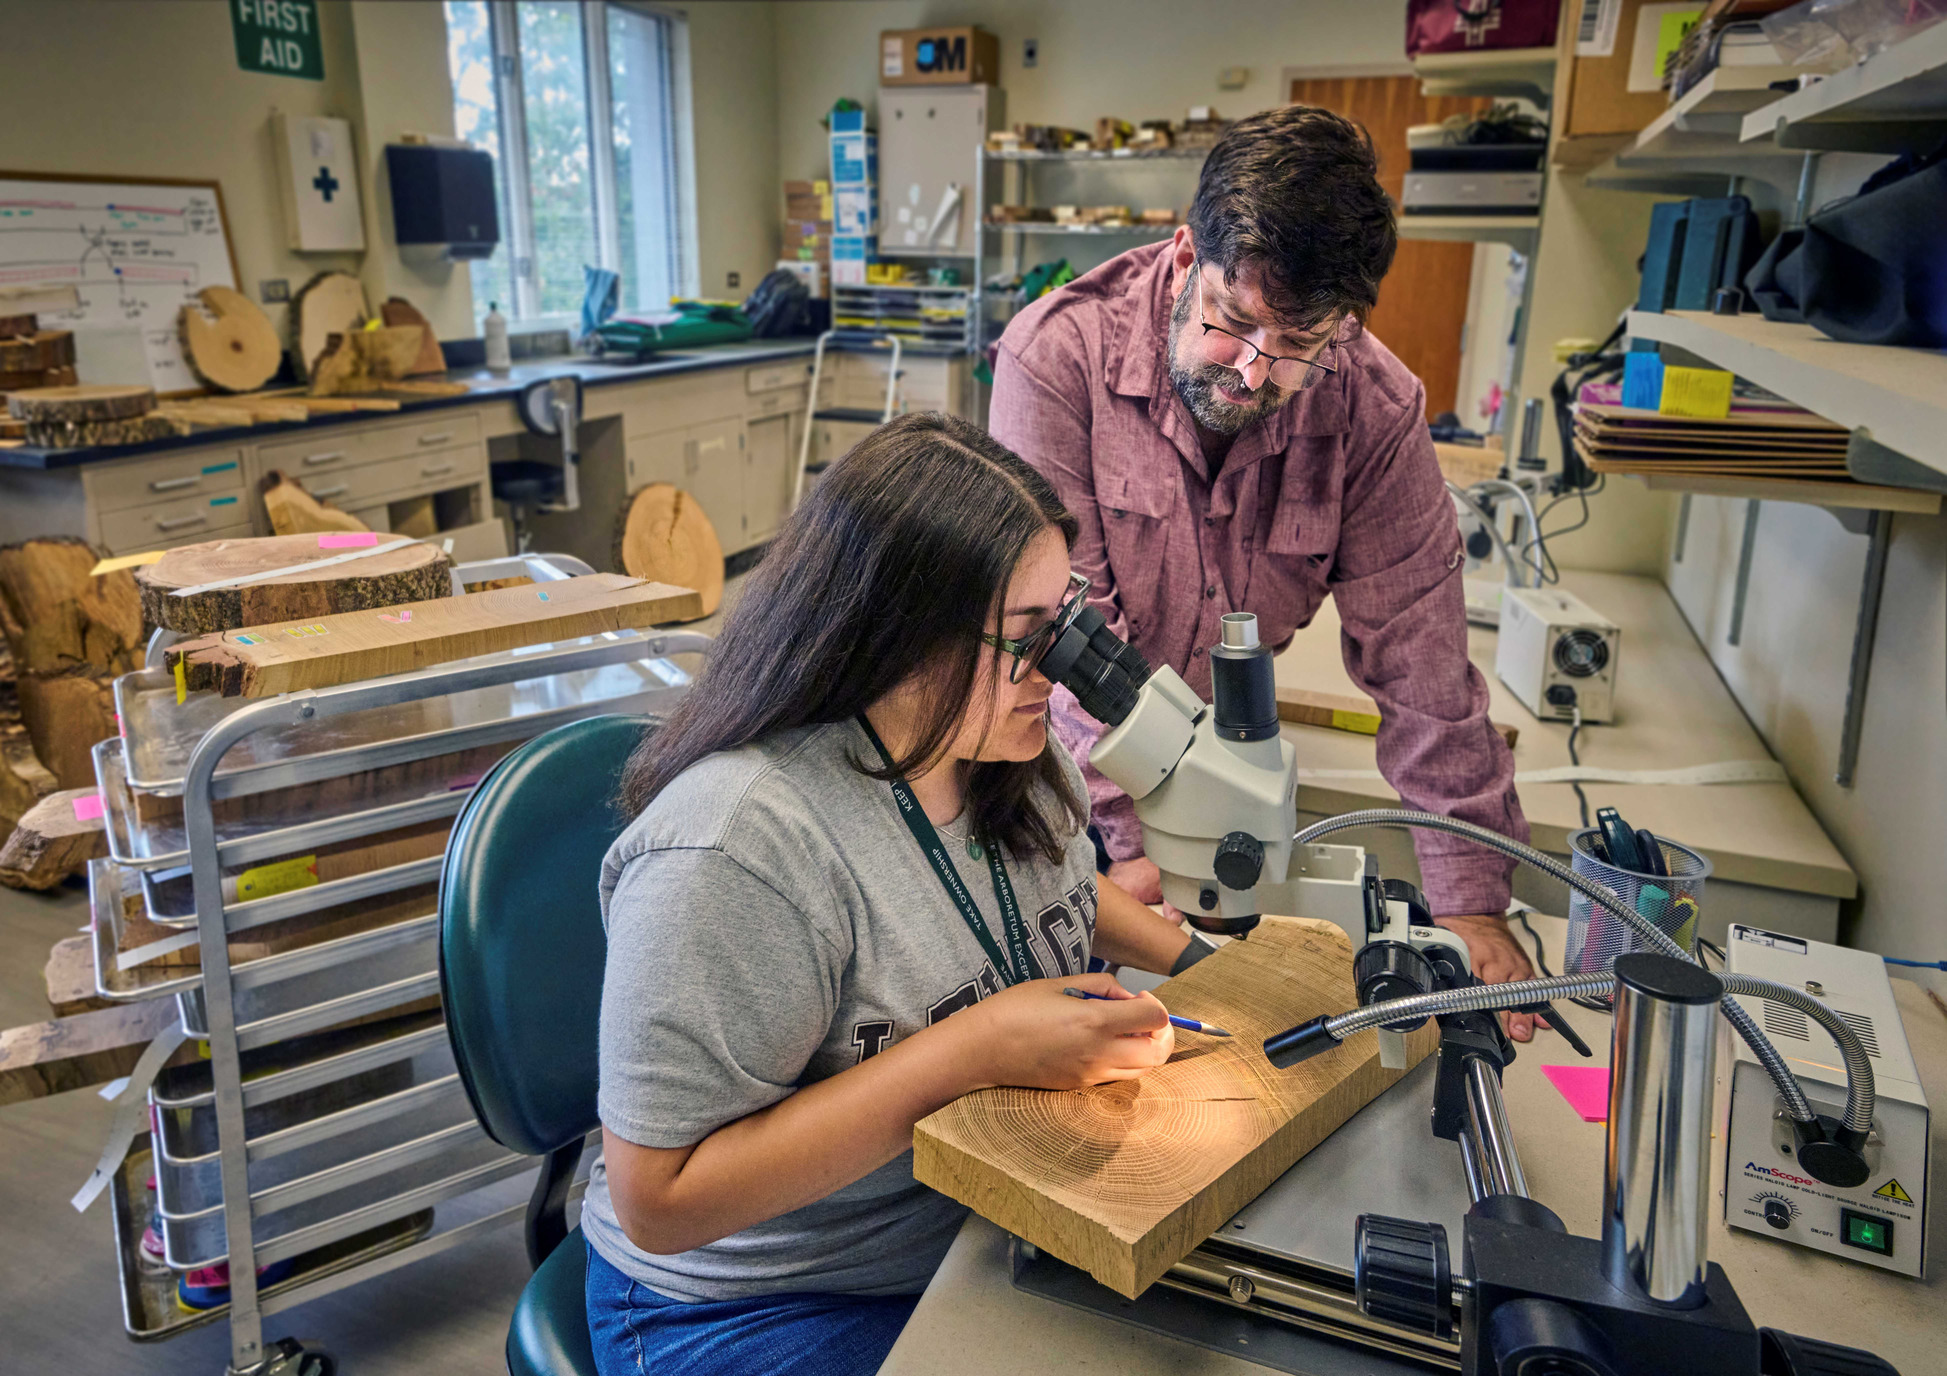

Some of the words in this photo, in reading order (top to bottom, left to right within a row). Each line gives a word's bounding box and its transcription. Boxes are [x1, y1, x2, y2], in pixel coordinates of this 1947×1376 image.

[239, 0, 310, 34] FIRST
[260, 37, 304, 70] AID
[894, 788, 914, 812] KEEP
[932, 848, 967, 904] OWNERSHIP
[966, 904, 982, 931] TAKE
[998, 874, 1020, 940] ARBORETUM
[1744, 1161, 1813, 1186] AmScope
[1744, 1171, 1763, 1181] SERIES
[1872, 1193, 1890, 1202] NOTICE
[1743, 1208, 1767, 1219] CONTRO
[1810, 1227, 1834, 1237] ON/OFF
